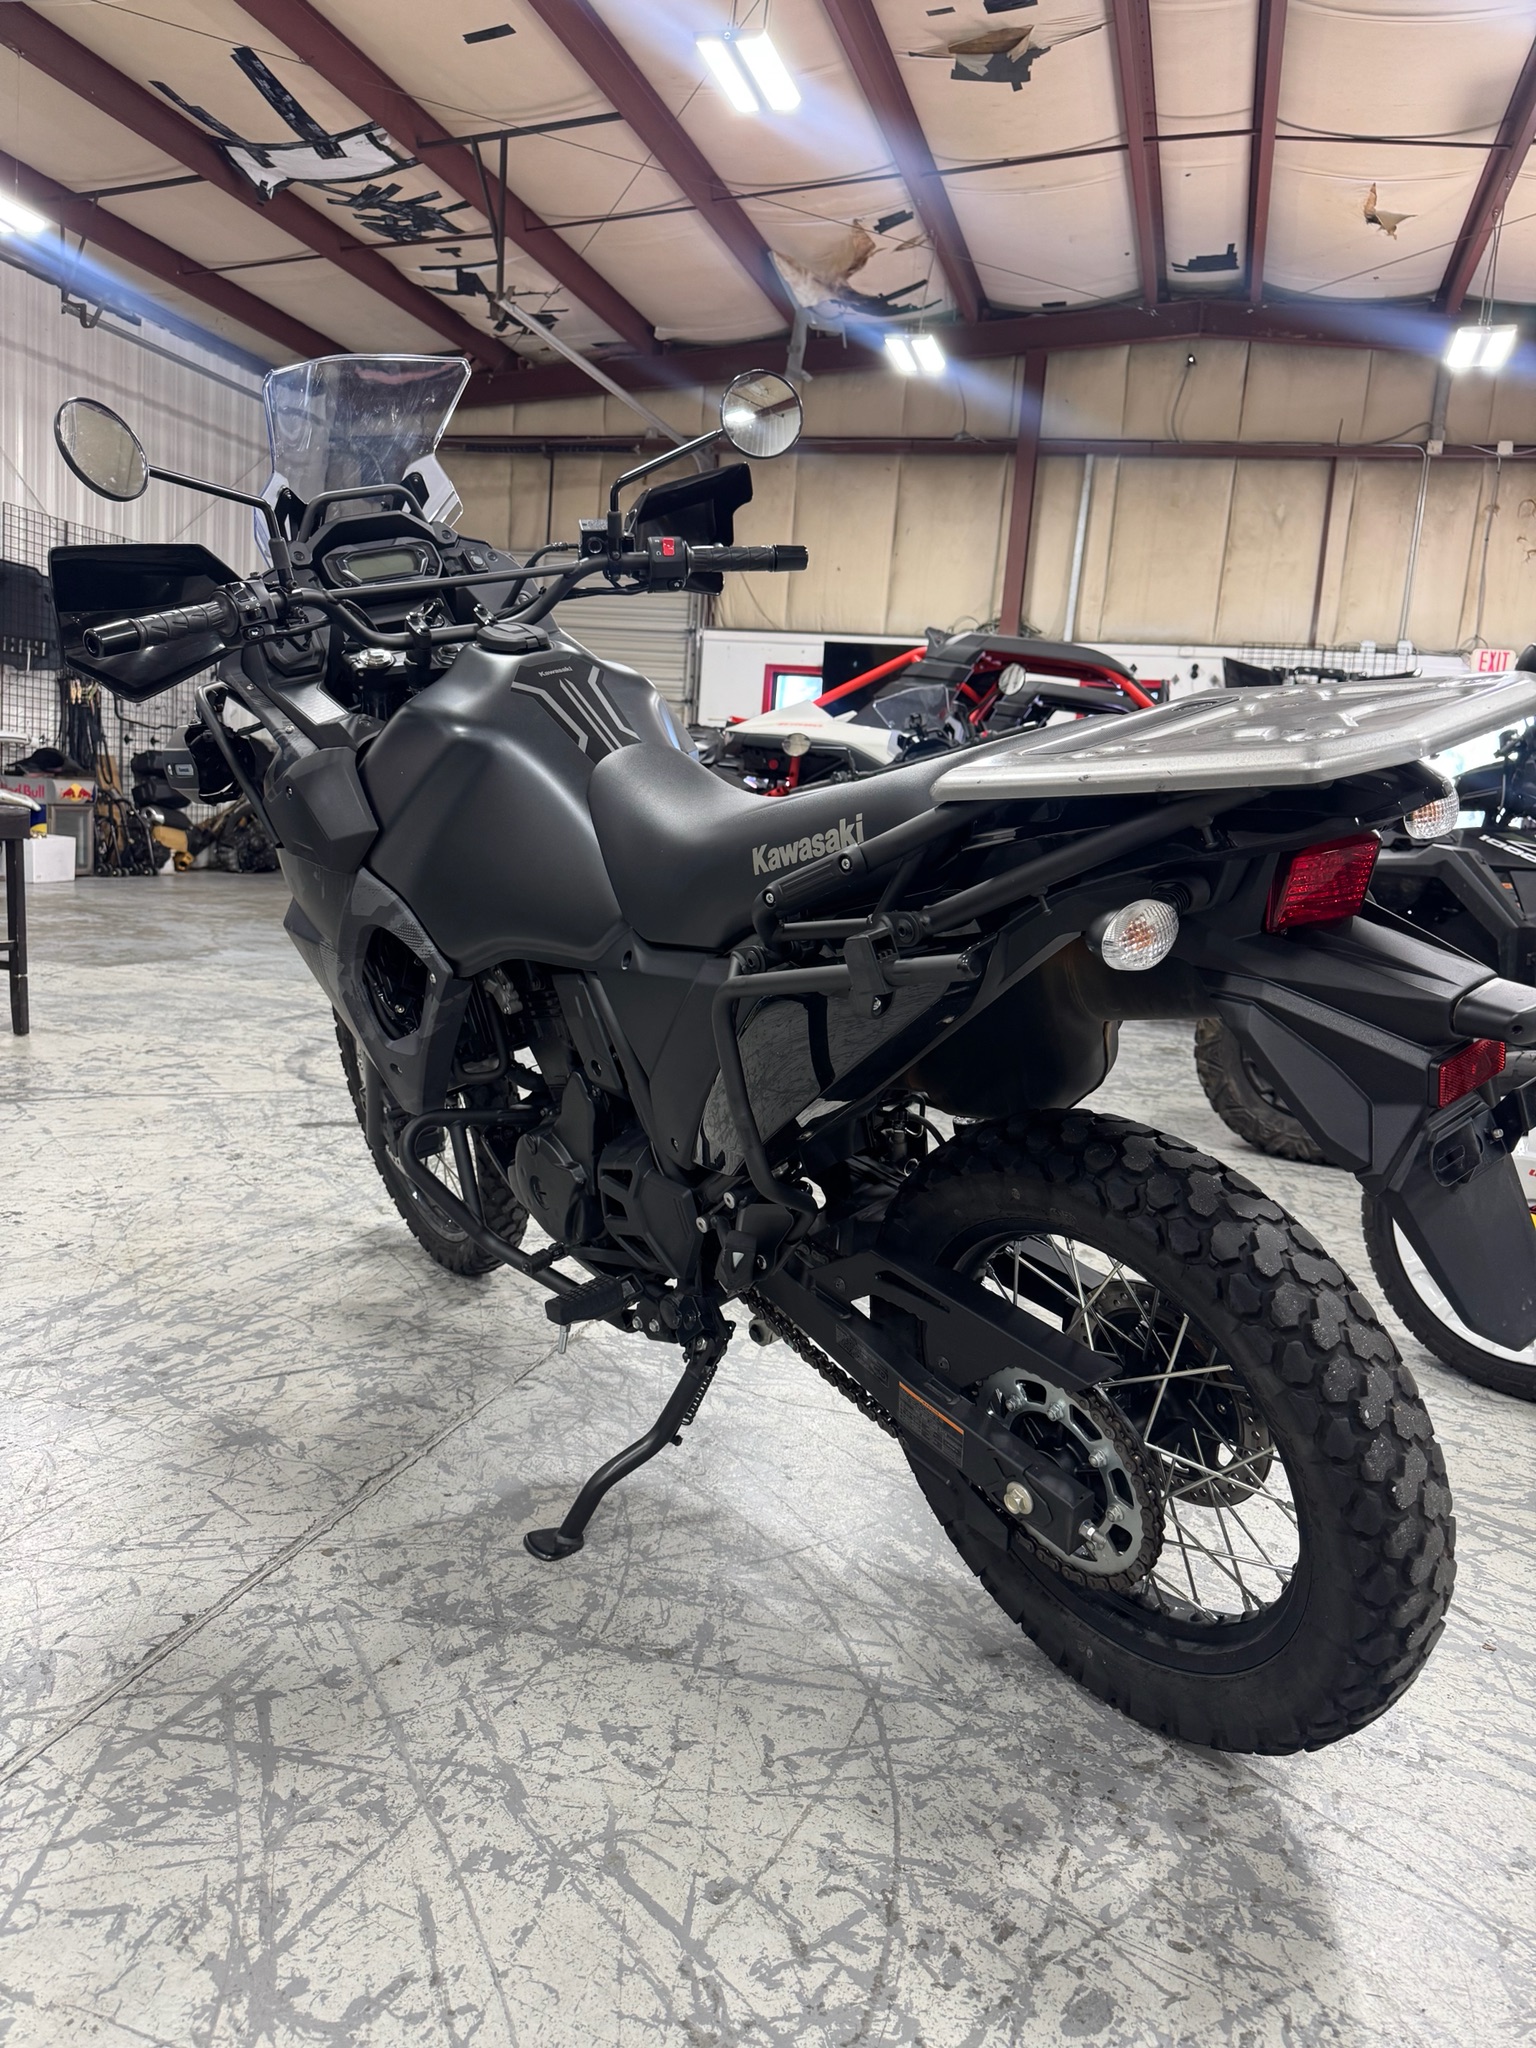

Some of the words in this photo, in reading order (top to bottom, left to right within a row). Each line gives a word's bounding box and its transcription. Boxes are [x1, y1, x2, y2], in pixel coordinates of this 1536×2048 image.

[1478, 651, 1510, 672] EXIT
[538, 666, 573, 677] Kawasaki
[23, 783, 45, 799] Bull
[752, 812, 865, 876] Kawasaki
